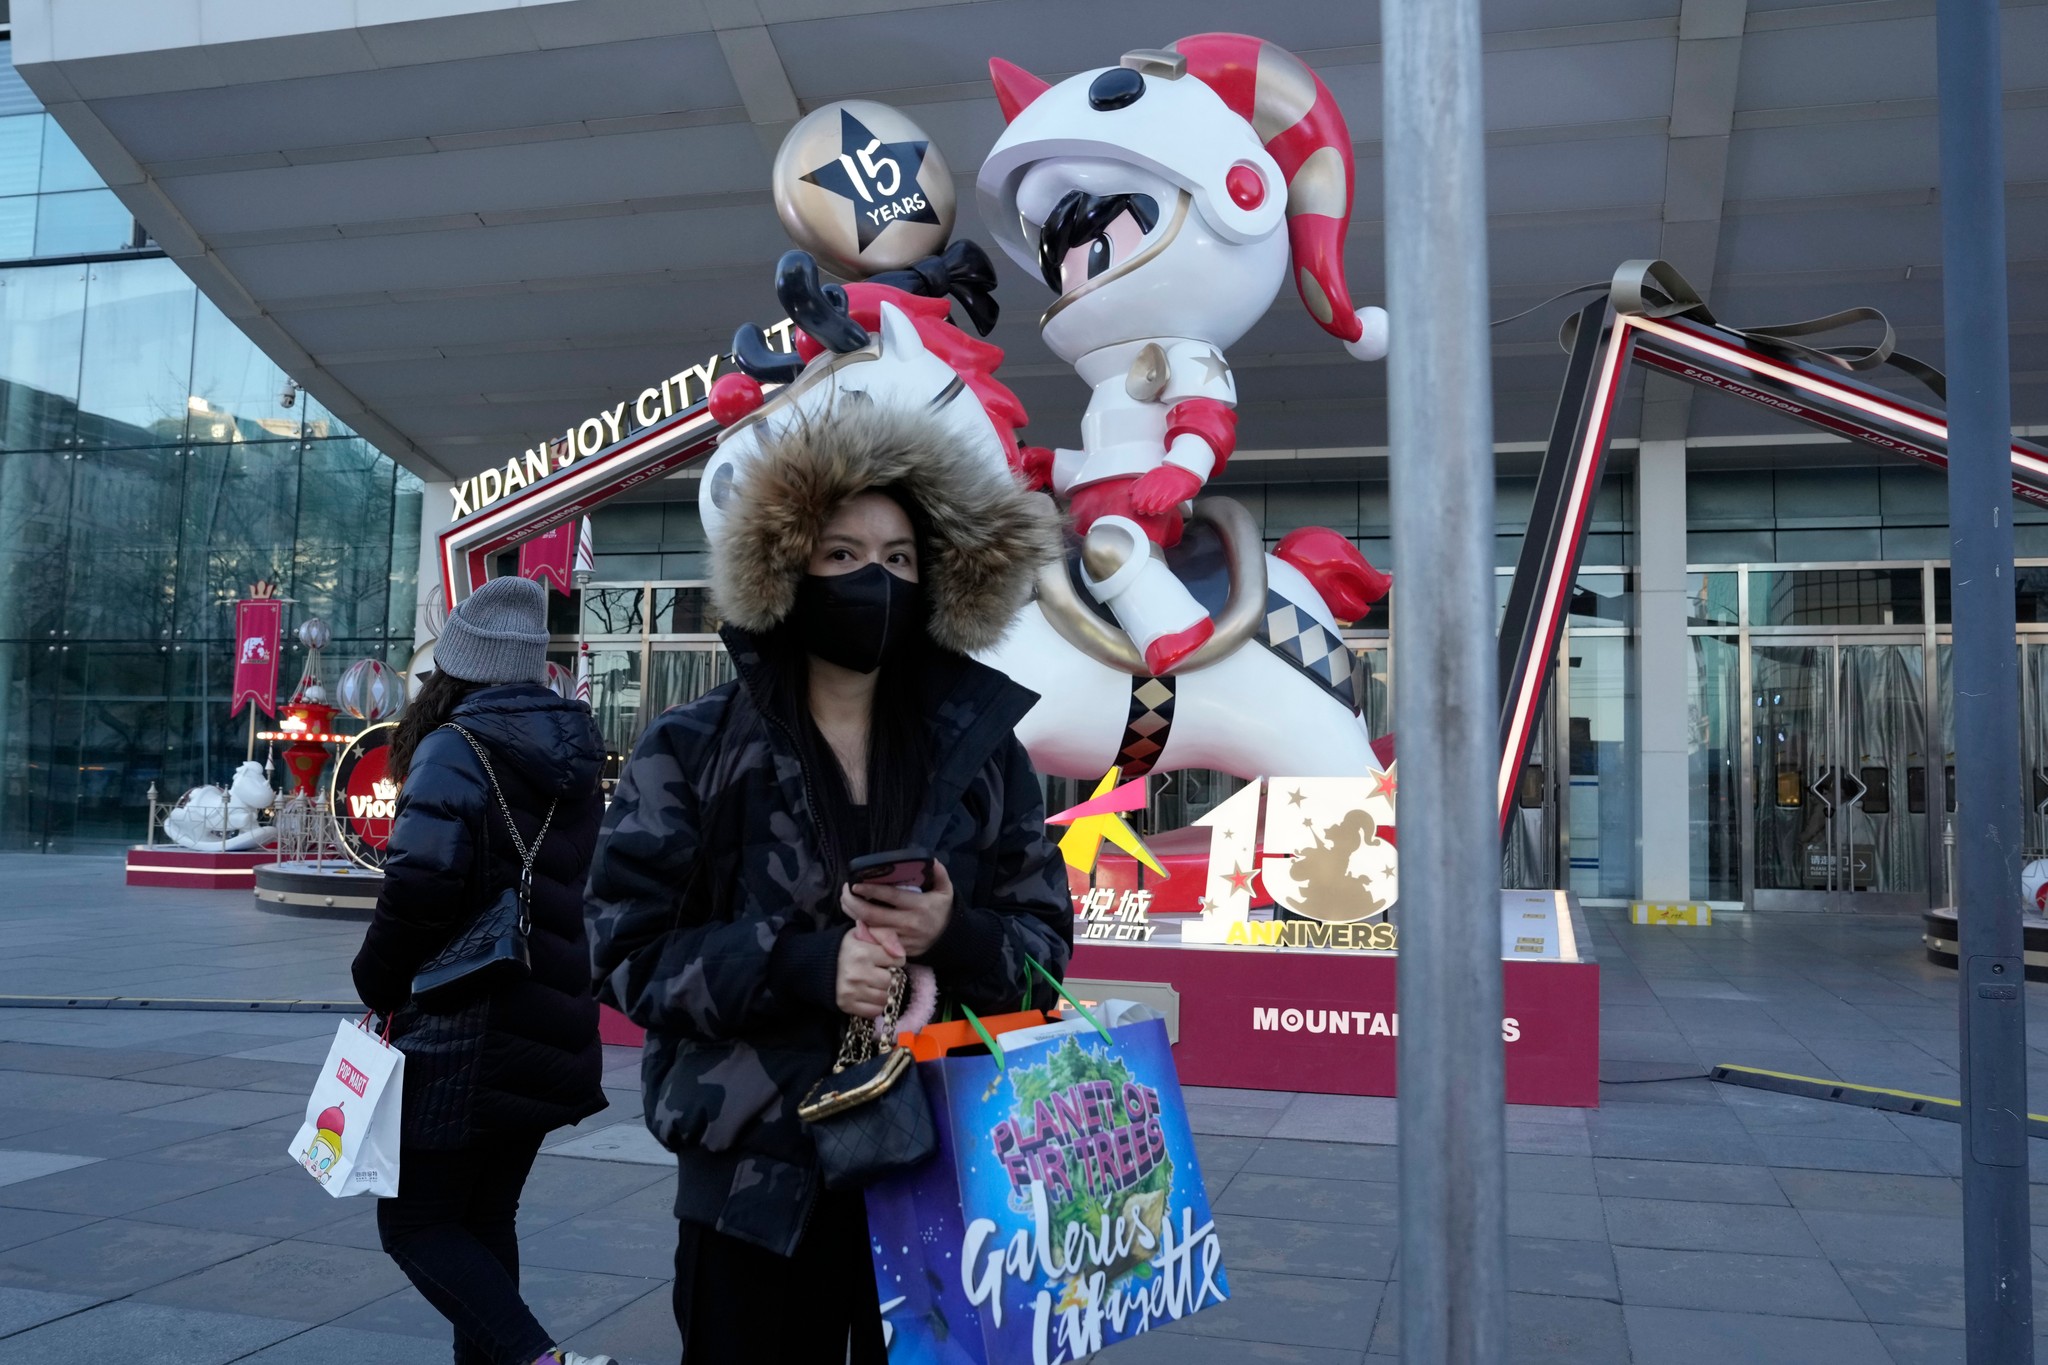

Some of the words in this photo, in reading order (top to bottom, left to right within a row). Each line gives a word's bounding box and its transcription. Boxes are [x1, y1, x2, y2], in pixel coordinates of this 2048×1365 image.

[838, 138, 901, 203] 15
[866, 192, 926, 226] YEARS
[1683, 368, 1722, 386] TOYS
[1724, 383, 1802, 414] MOUNTAIN
[449, 442, 552, 523] XIDAN
[557, 402, 627, 468] JOY
[635, 354, 720, 427] CITY
[1858, 433, 1895, 447] CITY
[1895, 446, 1928, 458] JOY
[1069, 887, 1153, 923] 悦城
[1081, 923, 1116, 939] JOY
[1115, 925, 1156, 942] CITY
[1226, 919, 1399, 950] ANNIVERS
[338, 1061, 352, 1081] POP
[348, 1069, 367, 1094] MART
[991, 1080, 1115, 1166] PLANET
[1121, 1081, 1161, 1125] OF
[1004, 1144, 1074, 1202] FIR
[1072, 1117, 1167, 1199] TREES
[961, 1179, 1156, 1329] Galeries
[1032, 1206, 1227, 1365] Lafayette
